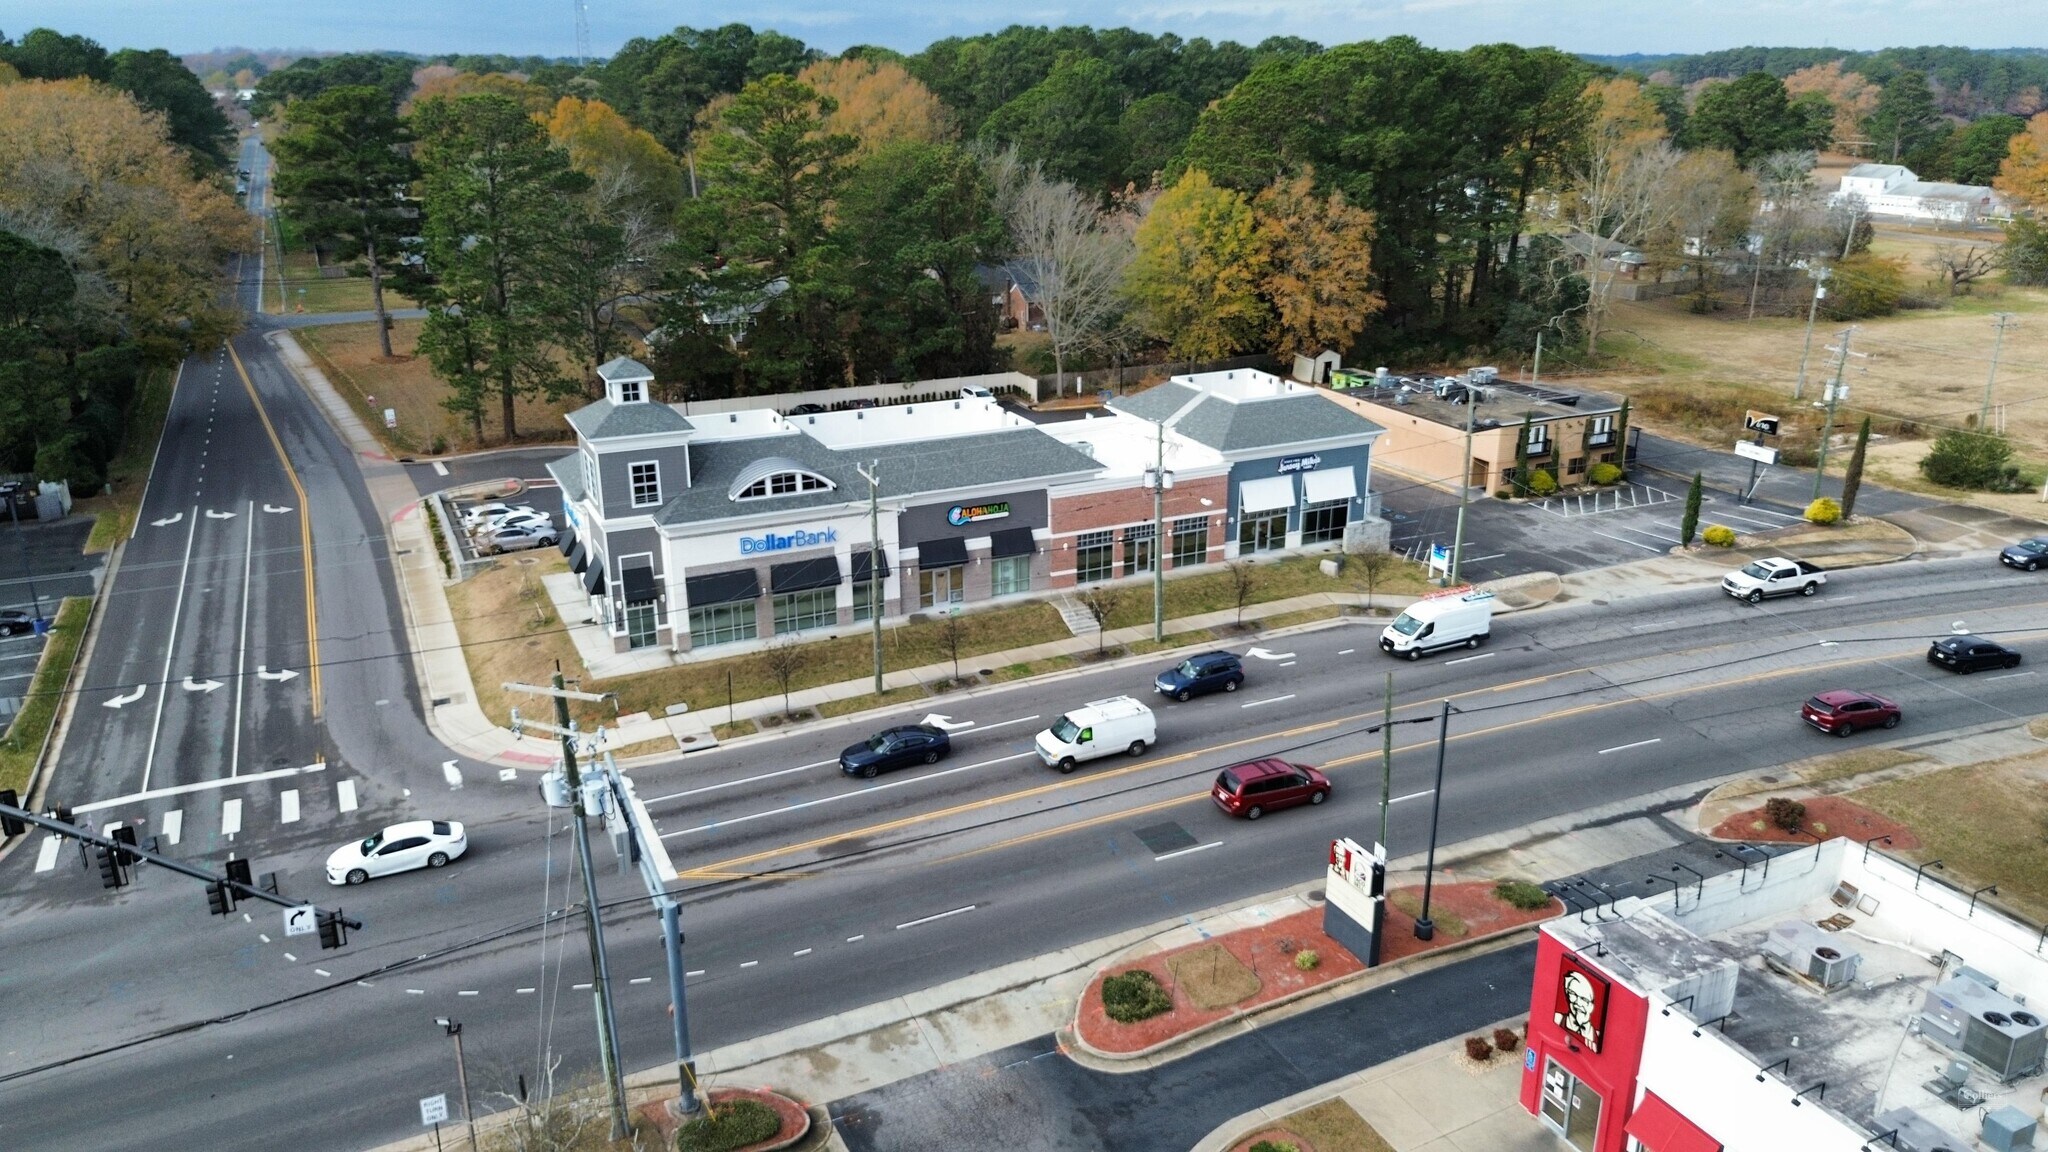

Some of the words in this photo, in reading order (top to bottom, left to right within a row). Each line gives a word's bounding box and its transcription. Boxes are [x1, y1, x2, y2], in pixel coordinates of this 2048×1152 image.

[423, 1098, 442, 1107] RIGHT
[425, 1105, 443, 1114] TURN
[426, 1112, 443, 1121] ONLY
